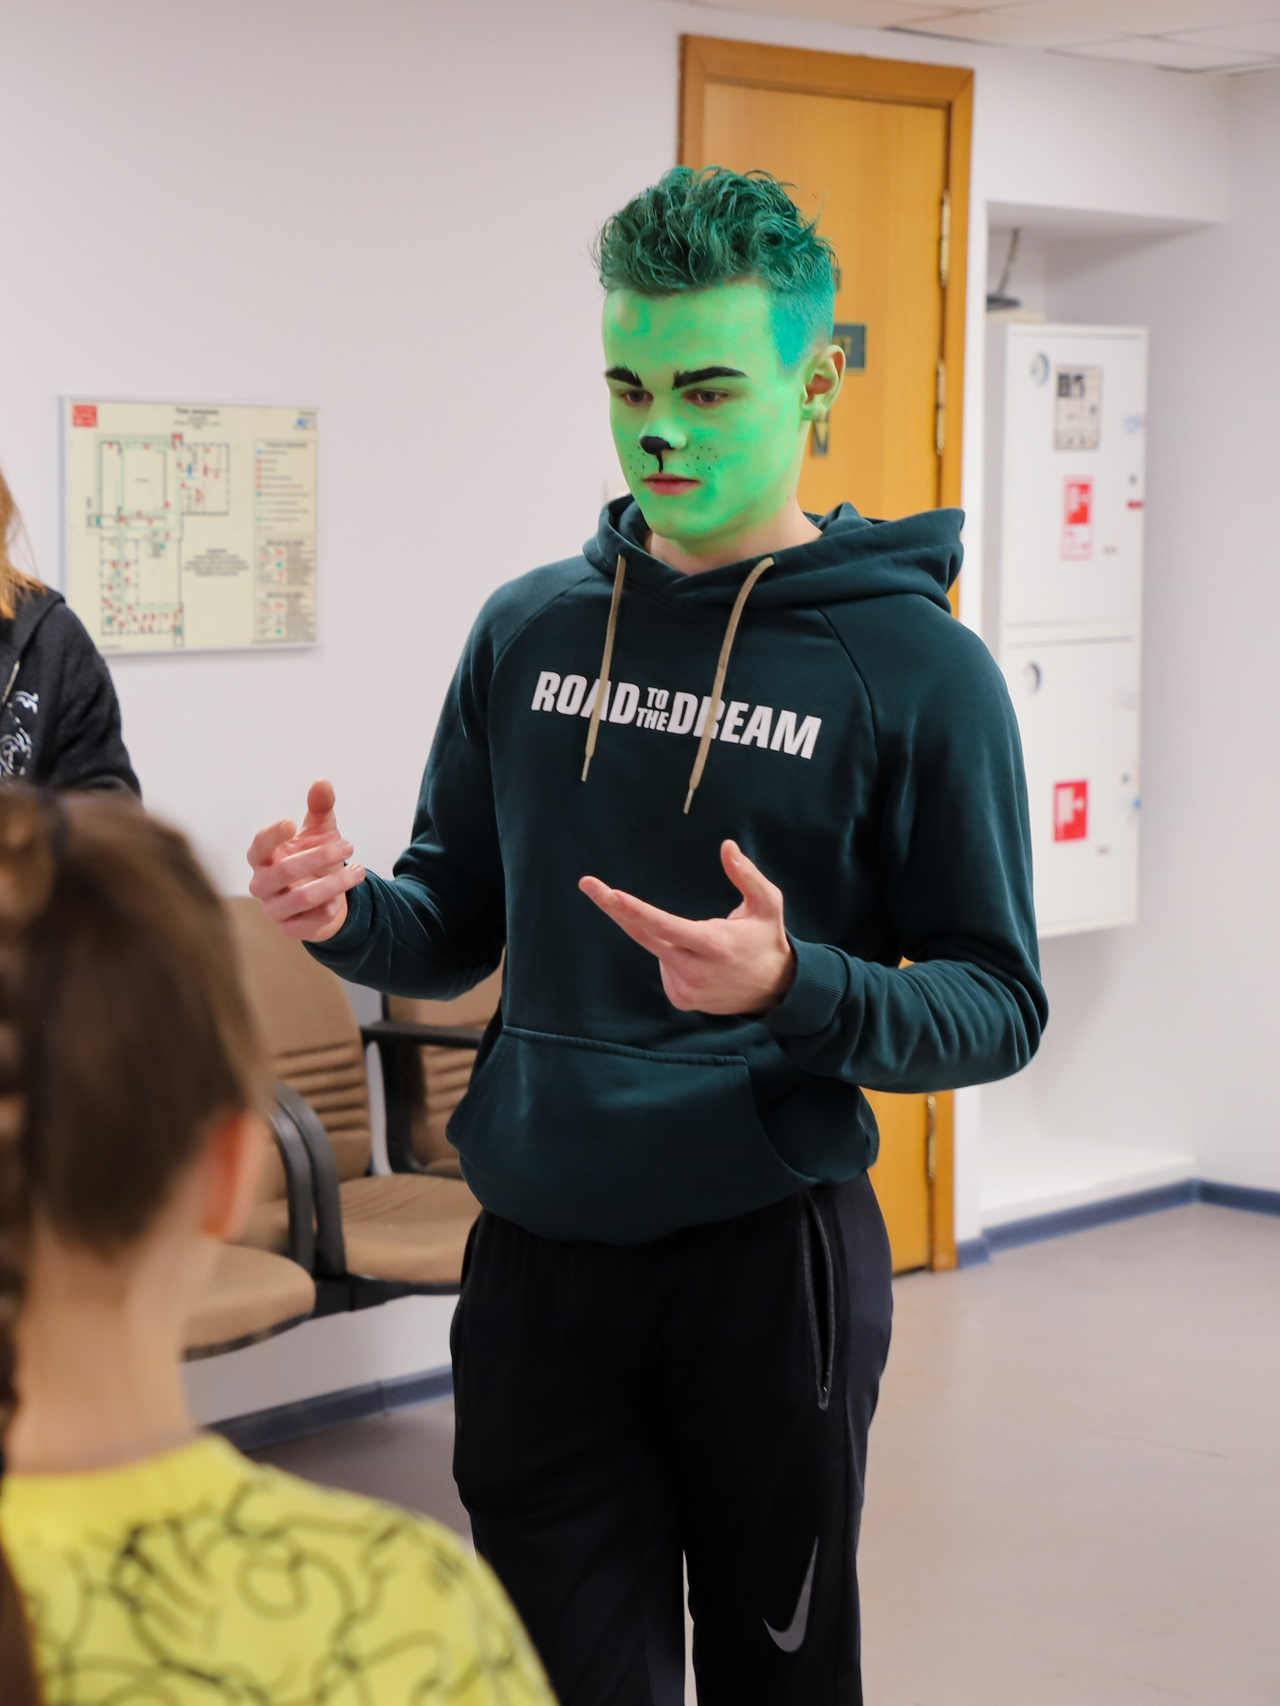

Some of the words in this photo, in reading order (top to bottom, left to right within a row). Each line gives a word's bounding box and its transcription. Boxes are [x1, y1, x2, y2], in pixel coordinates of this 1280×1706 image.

[530, 670, 641, 725] ROAD
[646, 686, 670, 710] TO
[636, 706, 670, 732] THE
[666, 691, 823, 760] DREAM
